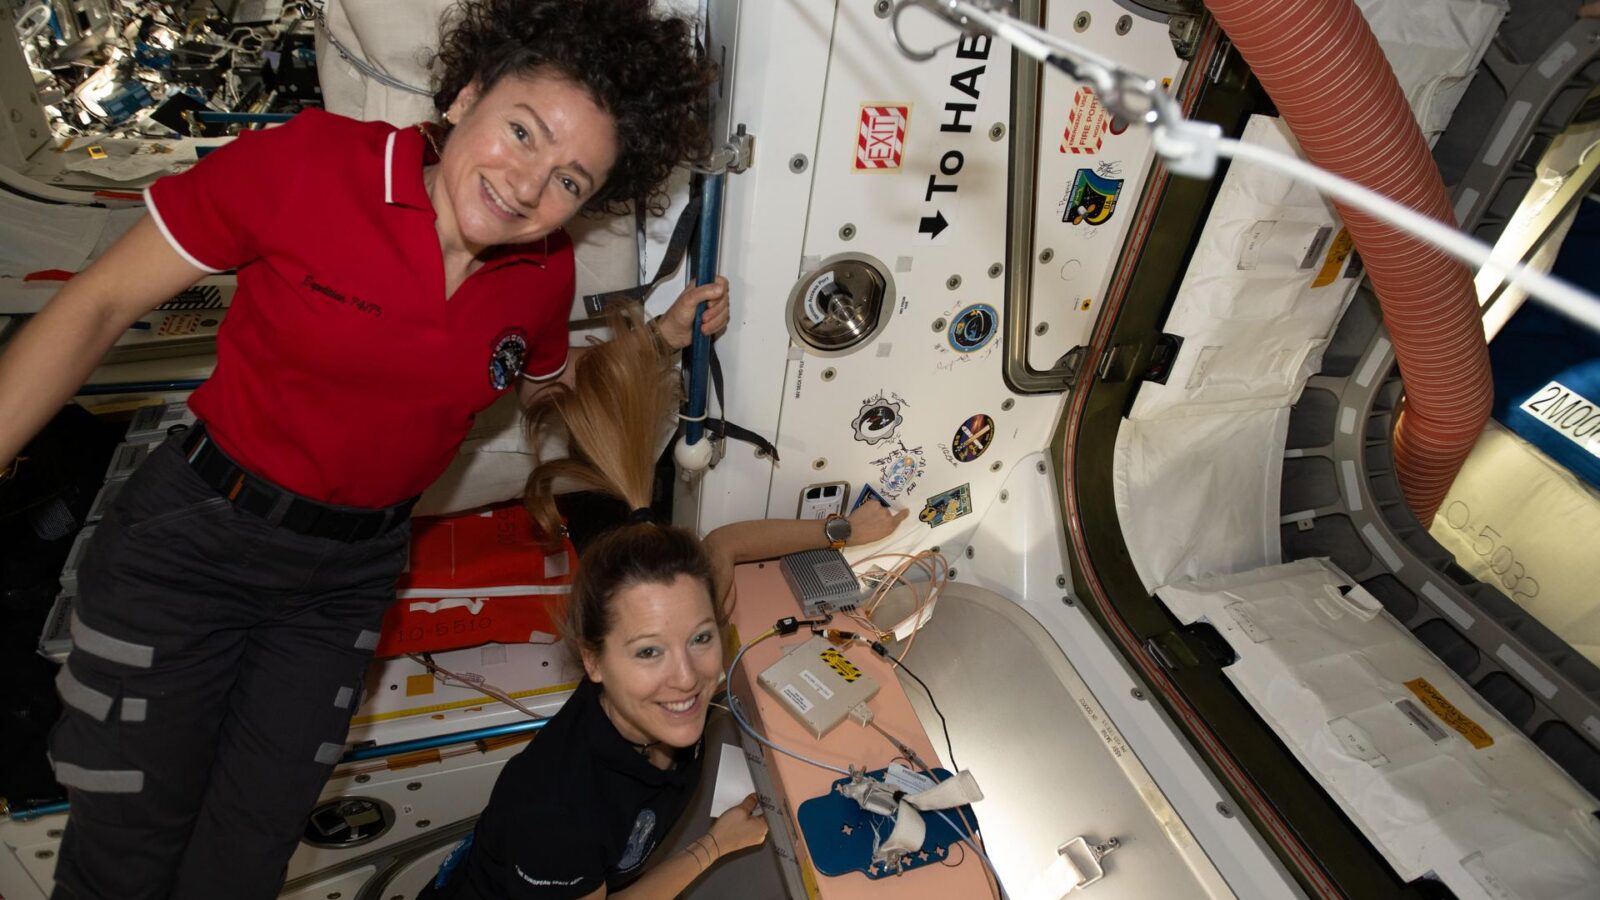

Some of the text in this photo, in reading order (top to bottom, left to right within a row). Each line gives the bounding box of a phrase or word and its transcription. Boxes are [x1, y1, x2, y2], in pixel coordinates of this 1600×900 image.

[940, 31, 992, 133] HAB
[868, 117, 896, 160] EXIT
[1069, 109, 1083, 146] EMERGENCY
[1079, 95, 1099, 146] FIRE PORT
[807, 285, 819, 303] Access
[818, 276, 829, 287] Port
